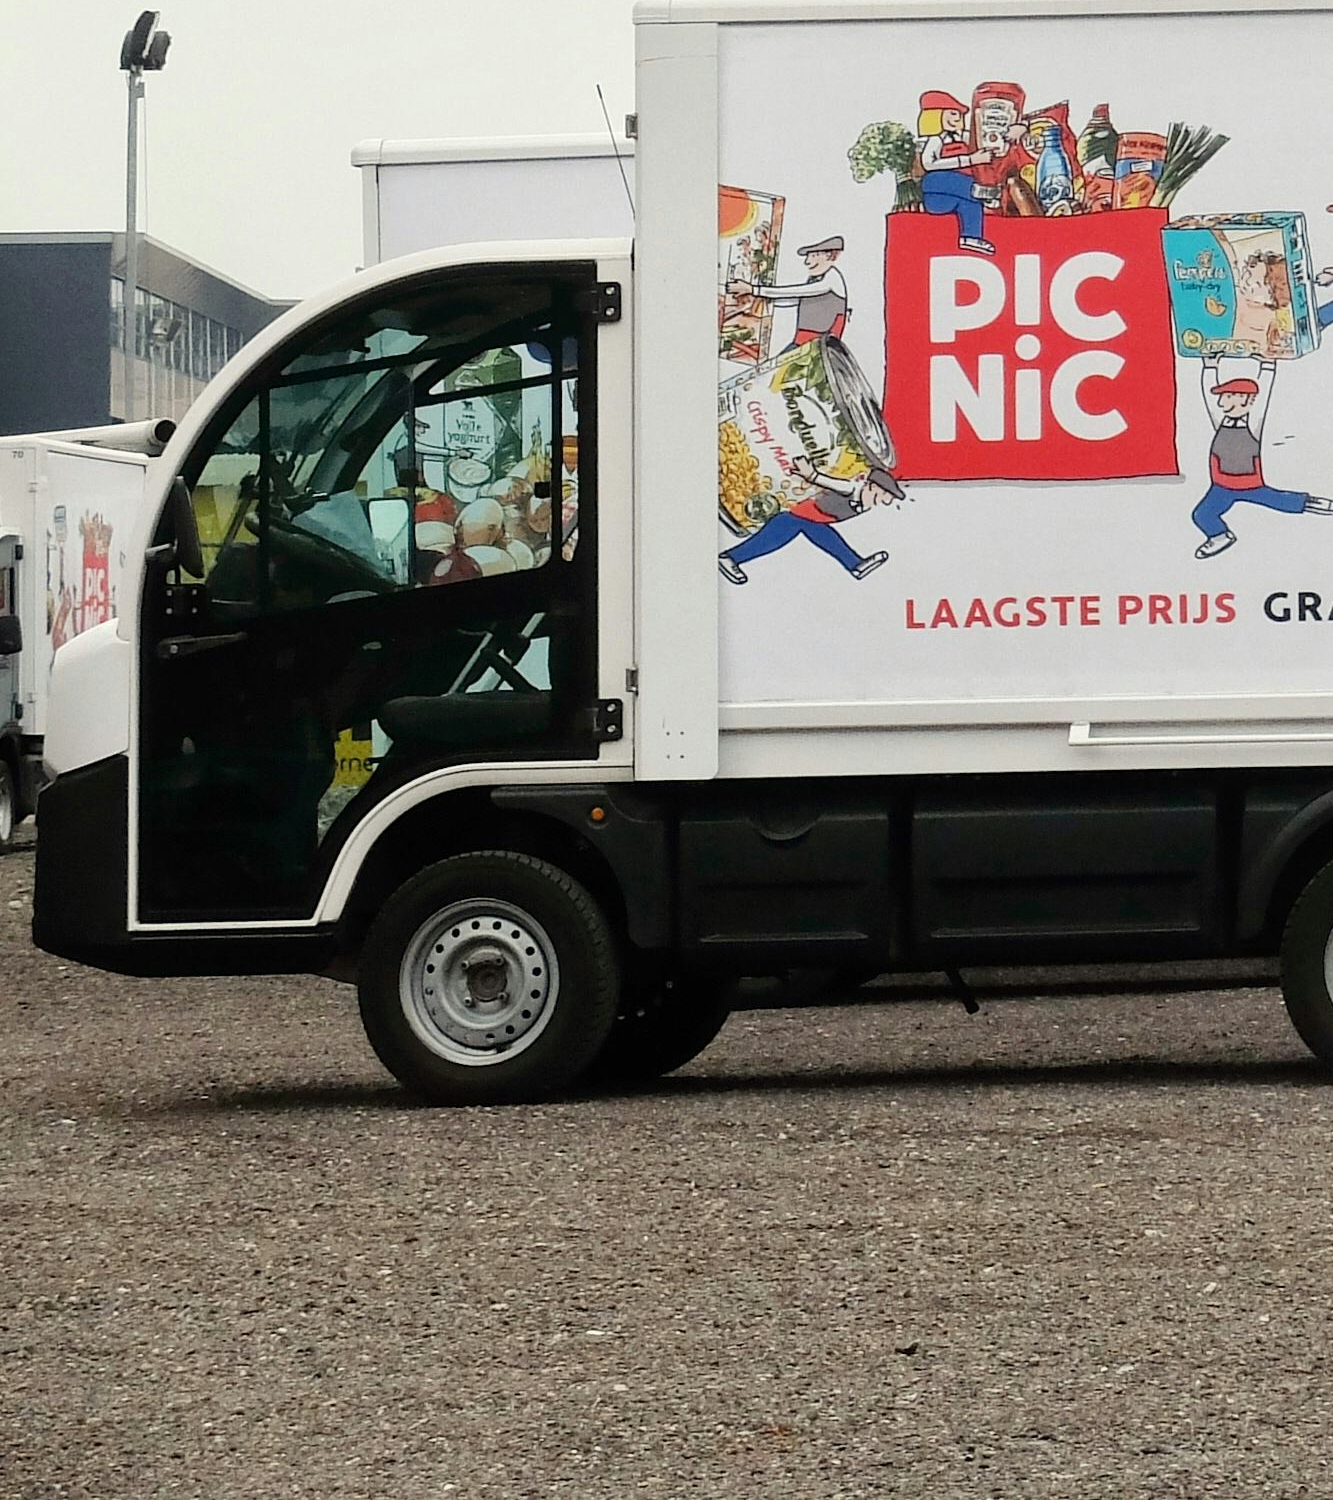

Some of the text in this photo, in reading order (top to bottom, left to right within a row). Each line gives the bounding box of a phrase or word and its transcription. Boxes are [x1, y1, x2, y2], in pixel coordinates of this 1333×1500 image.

[929, 251, 1127, 342] PIC
[746, 400, 773, 446] Crispy
[905, 595, 1101, 630] LAAGSTE
[1118, 591, 1237, 626] PRIJS
